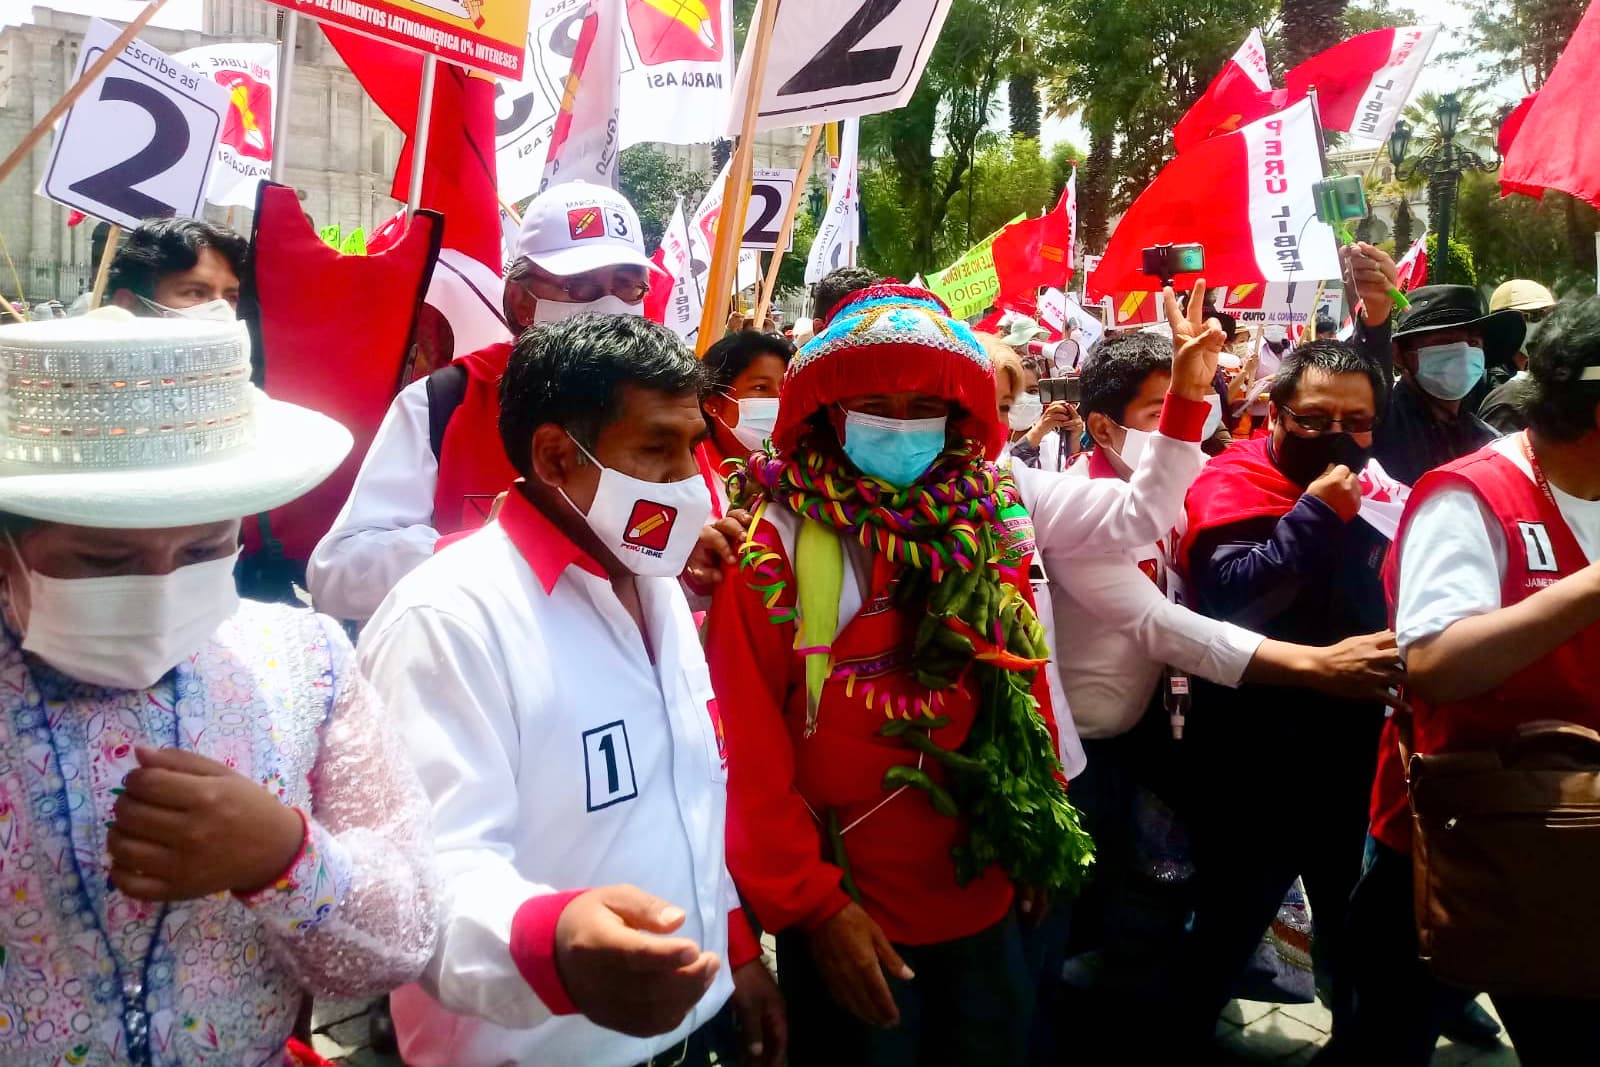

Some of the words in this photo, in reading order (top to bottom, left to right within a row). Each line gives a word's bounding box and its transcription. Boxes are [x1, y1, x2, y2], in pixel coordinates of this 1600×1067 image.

[330, 0, 387, 28] ALIMENTOS
[387, 13, 460, 52] LATINOAMERICA
[460, 38, 474, 56] 0%
[475, 44, 518, 70] INTERESES
[124, 41, 177, 79] Escribe
[180, 71, 200, 91] así
[68, 76, 190, 219] 2
[612, 213, 628, 236] 3
[742, 184, 782, 244] 2
[1242, 311, 1266, 321] QUITO
[1268, 312, 1277, 321] AL
[1528, 527, 1547, 565] 1
[598, 733, 620, 793] 1
